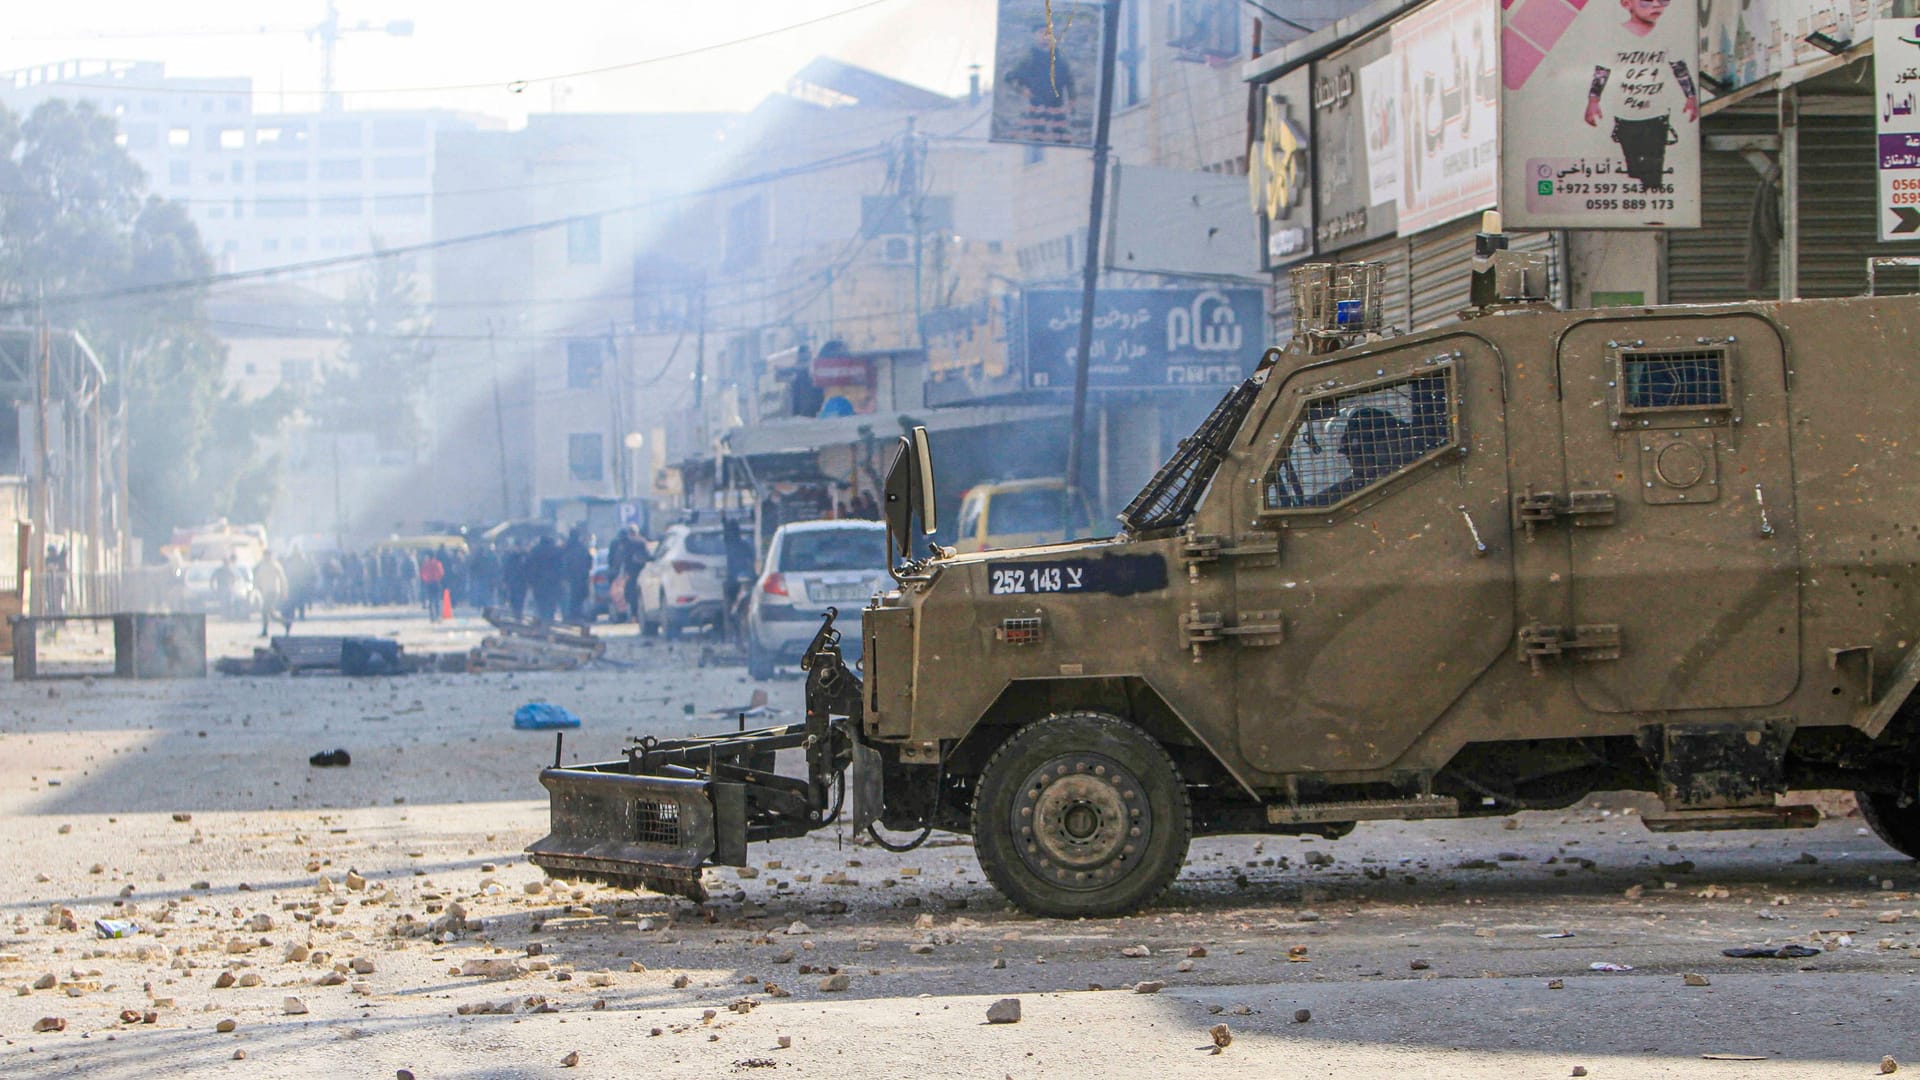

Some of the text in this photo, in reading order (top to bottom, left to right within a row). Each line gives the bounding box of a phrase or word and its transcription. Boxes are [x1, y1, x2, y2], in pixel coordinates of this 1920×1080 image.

[1626, 69, 1649, 80] OF
[1556, 158, 1592, 182] وأخي
[1595, 158, 1611, 174] أنا
[1556, 183, 1590, 194] +972
[1594, 183, 1617, 194] 597
[1622, 183, 1646, 194] 543
[1586, 199, 1674, 210] 0595 889 173
[1168, 290, 1243, 351] شام
[992, 570, 1026, 594] 252
[1030, 568, 1062, 593] 143
